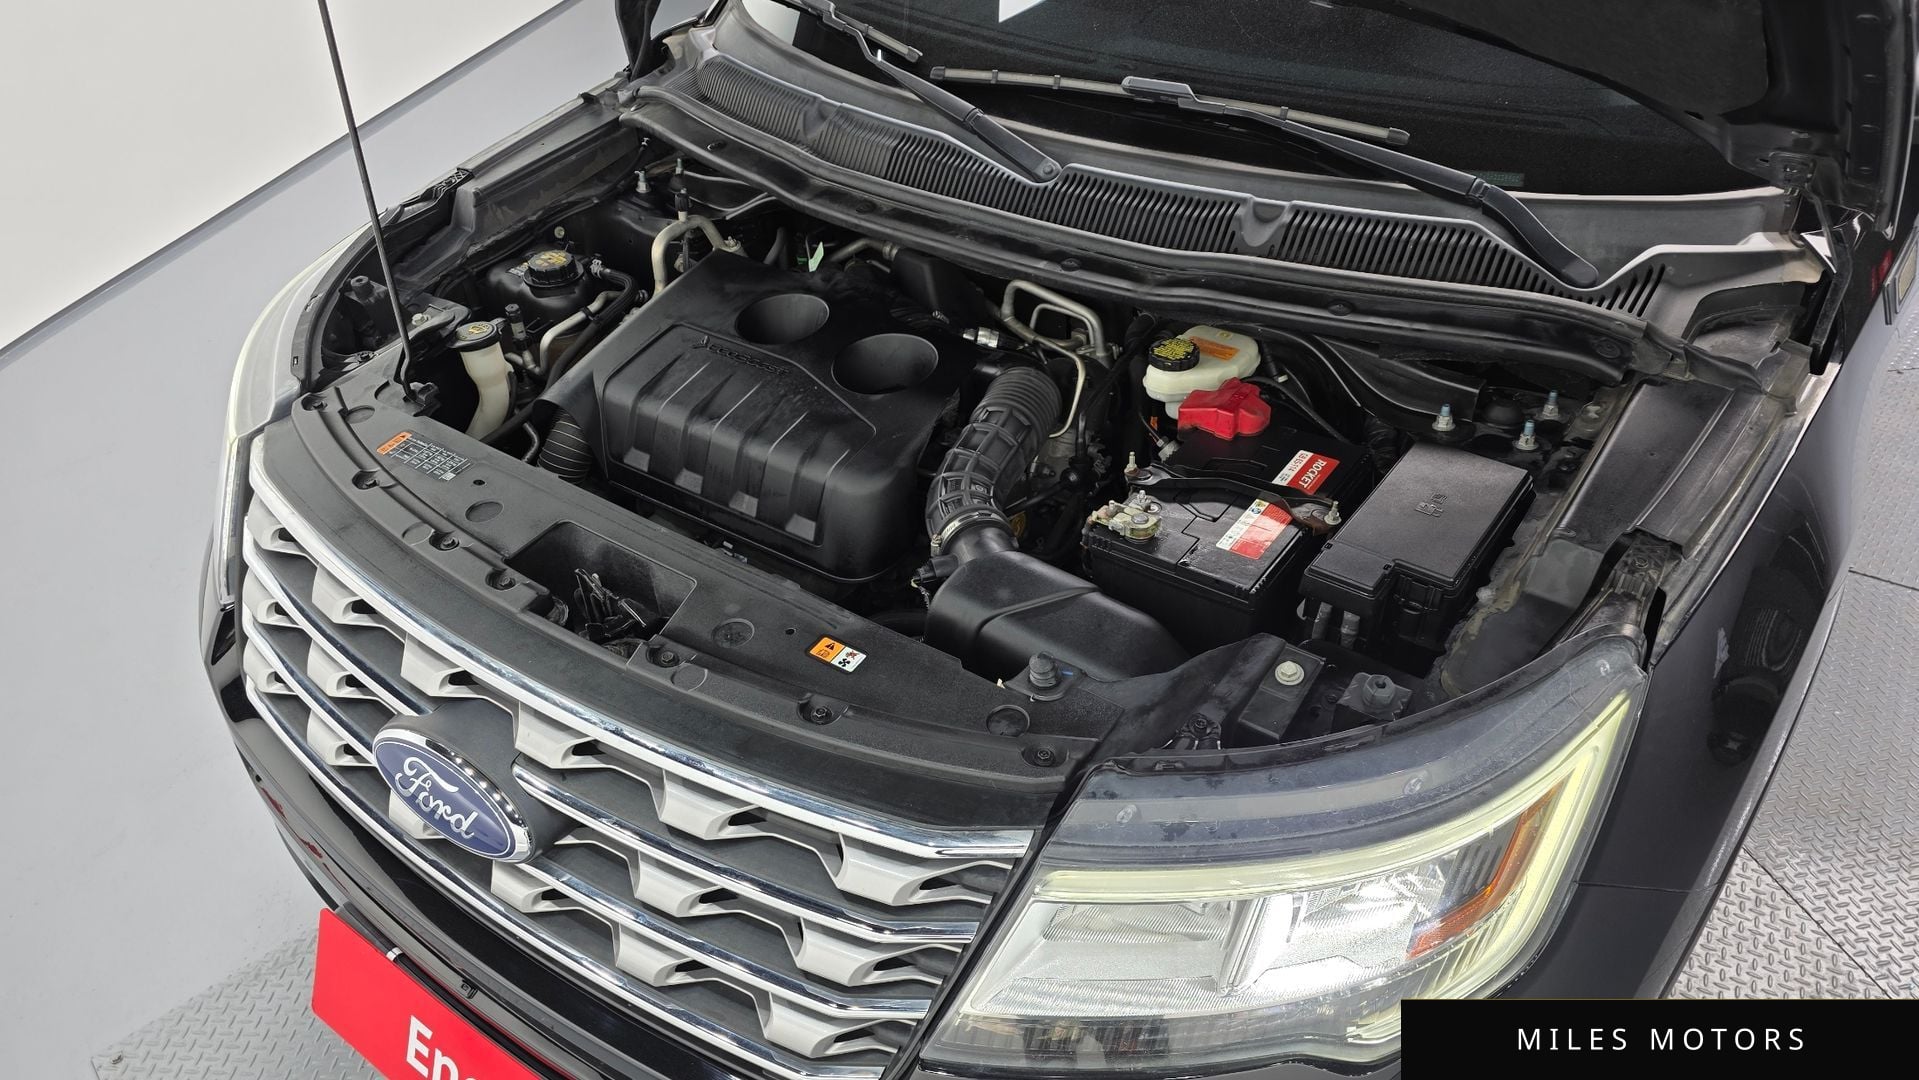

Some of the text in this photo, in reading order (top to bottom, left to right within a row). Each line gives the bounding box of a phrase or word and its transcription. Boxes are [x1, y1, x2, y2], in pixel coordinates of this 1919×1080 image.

[1298, 459, 1327, 488] ROCKET
[394, 756, 479, 839] Ford
[406, 1015, 477, 1080] En
